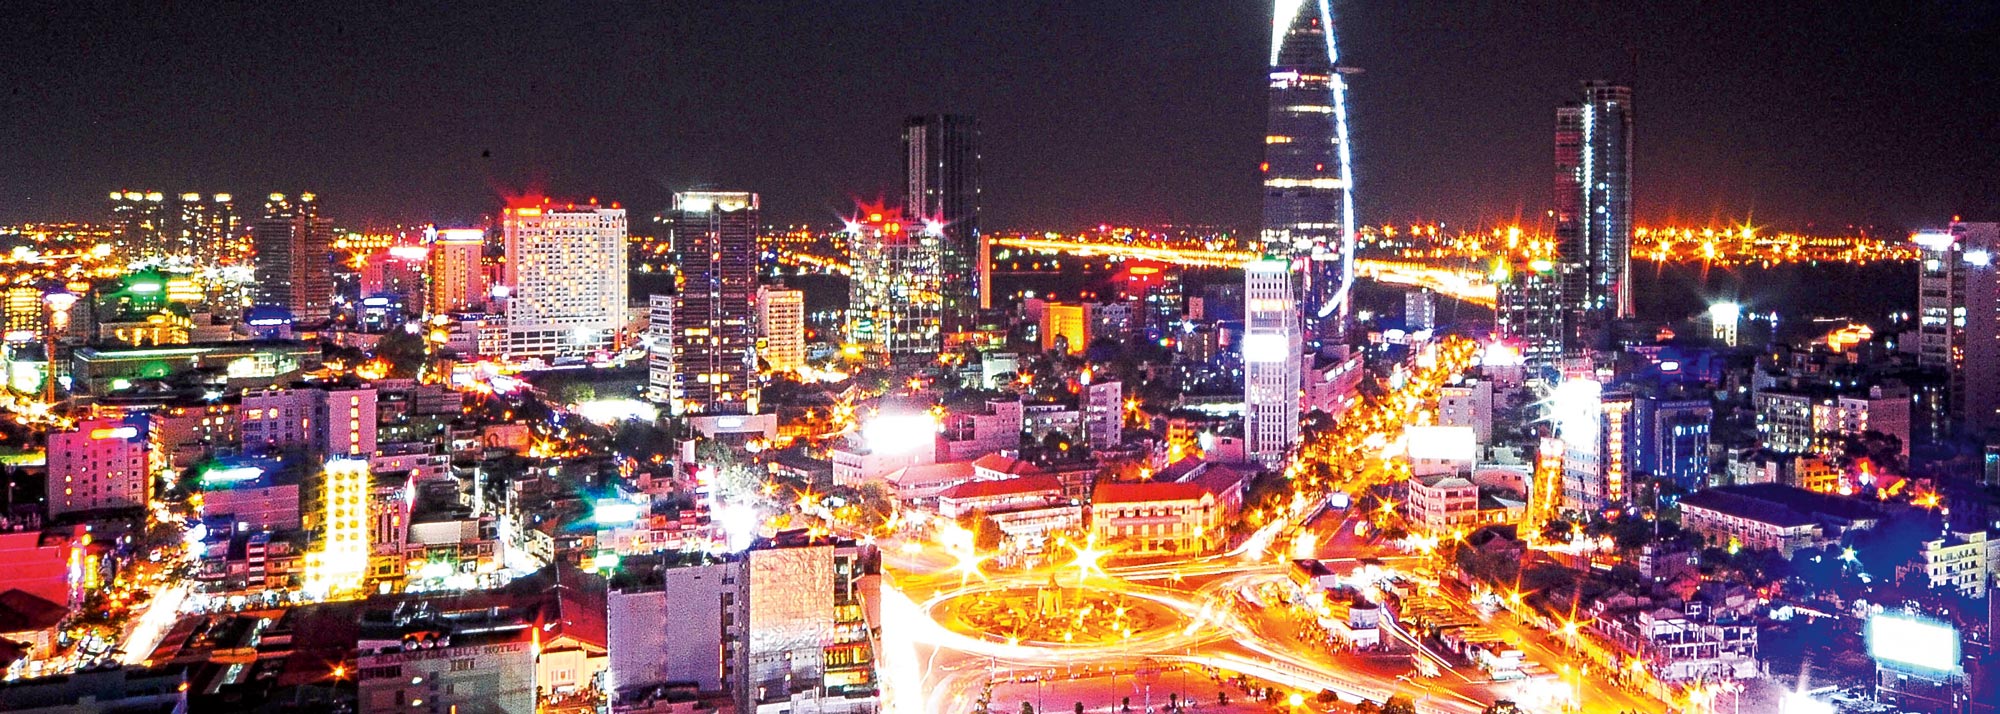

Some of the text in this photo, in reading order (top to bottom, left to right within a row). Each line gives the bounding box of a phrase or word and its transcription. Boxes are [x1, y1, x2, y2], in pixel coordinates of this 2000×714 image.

[426, 648, 449, 660] GIA
[454, 646, 479, 657] HUY
[484, 643, 520, 655] HOTEL
